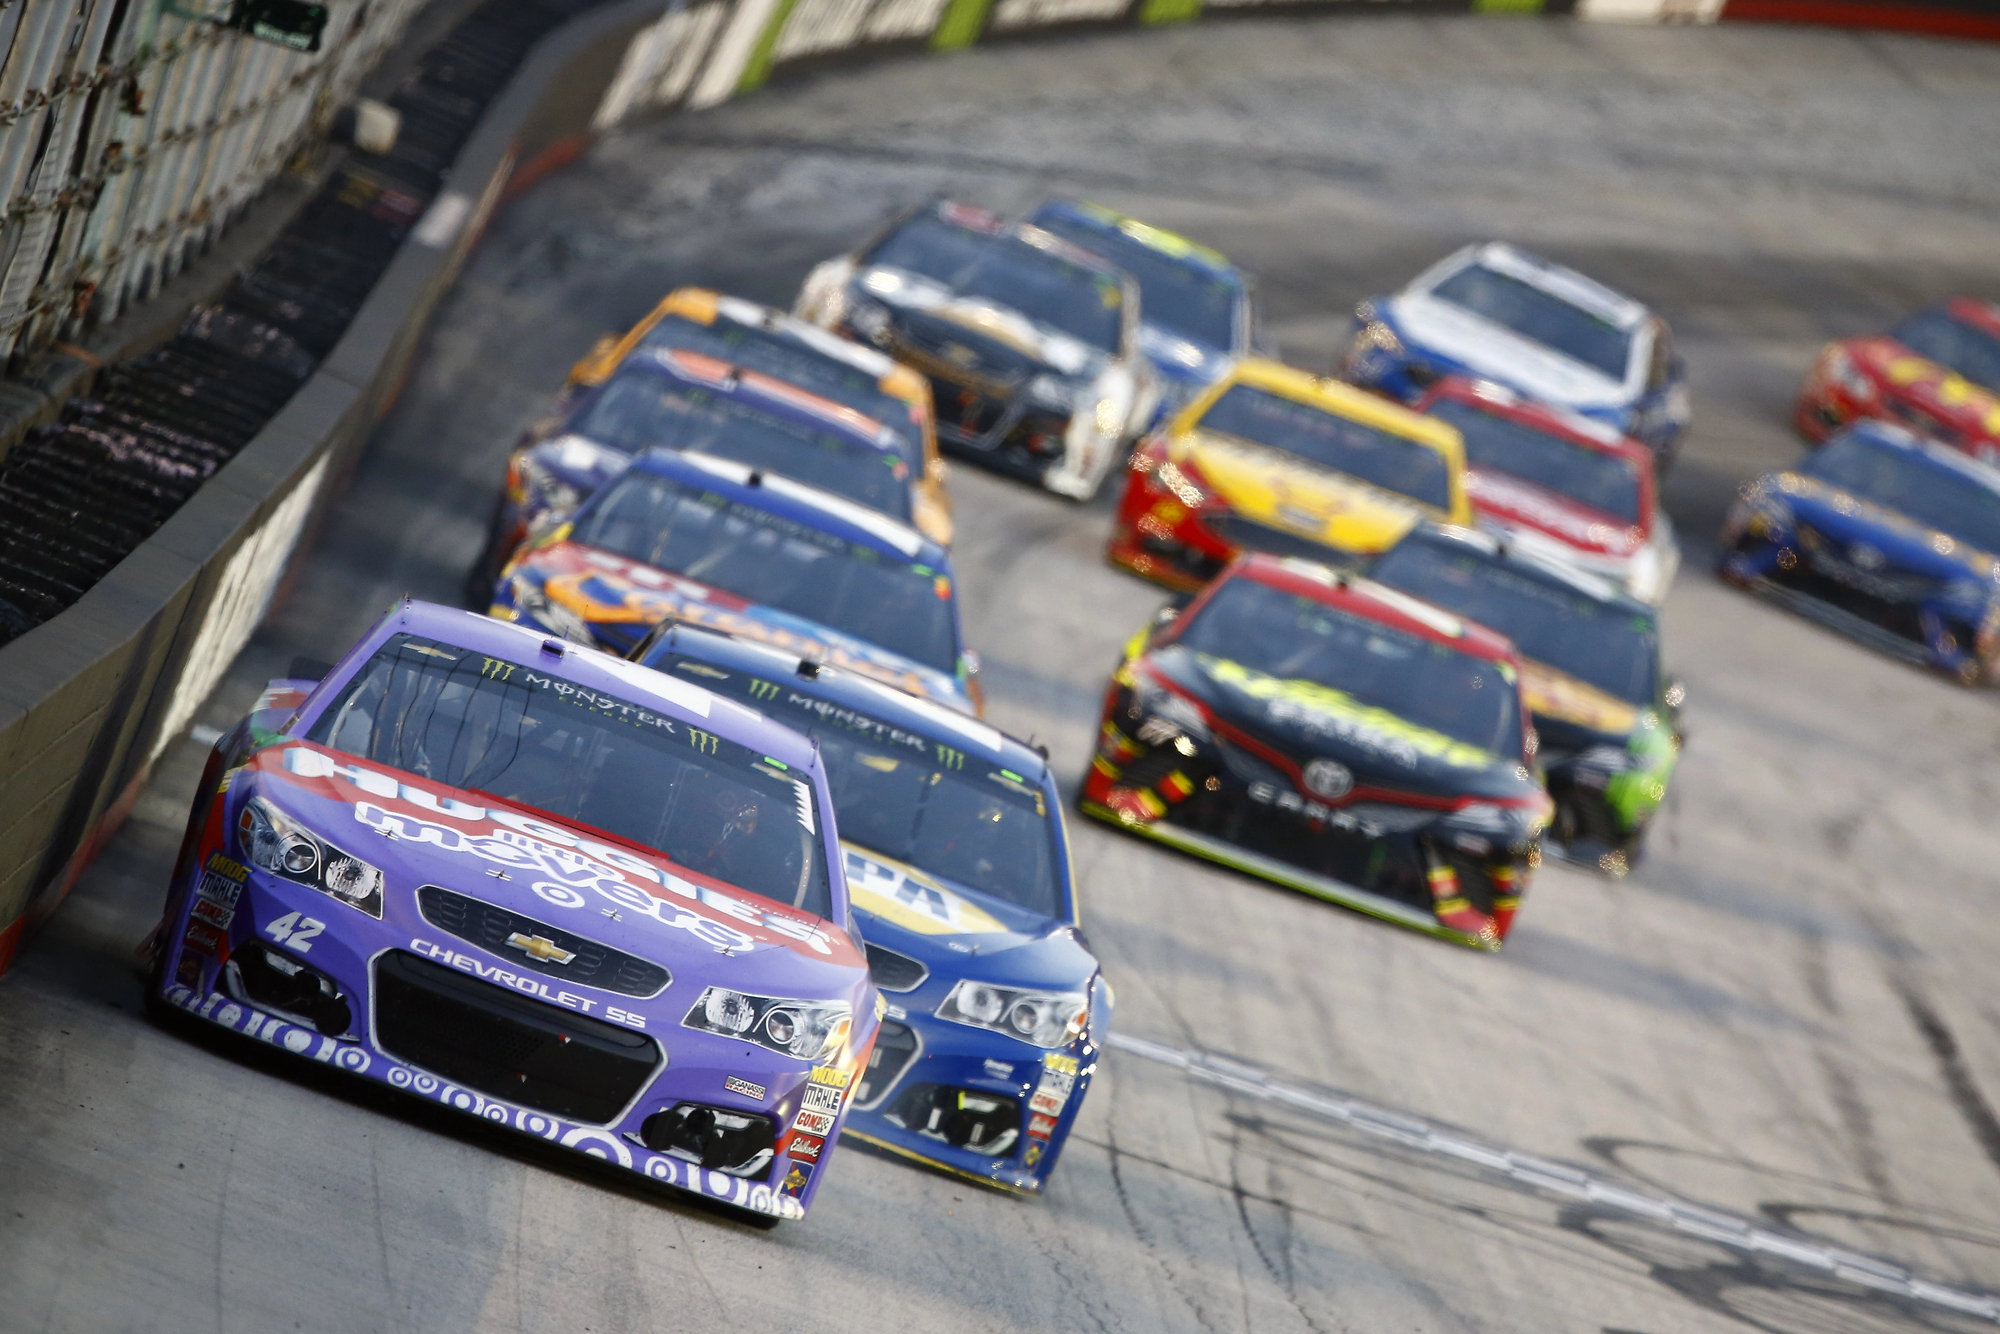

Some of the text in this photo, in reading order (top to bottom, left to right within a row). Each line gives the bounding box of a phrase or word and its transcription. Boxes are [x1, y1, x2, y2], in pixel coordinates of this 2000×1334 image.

[525, 673, 675, 734] MONSTER
[788, 693, 926, 751] MONSTER
[206, 852, 253, 883] MOOG
[284, 747, 833, 955] HUGGIES
[200, 876, 242, 903] MAHLE
[355, 801, 755, 952] movers
[846, 852, 951, 922] PA
[264, 911, 327, 954] 42
[409, 938, 647, 1029] CHEVROLET SS
[726, 1083, 763, 1099] RACING
[811, 1065, 849, 1087] MOOG
[796, 1112, 823, 1128] COMP
[803, 1086, 841, 1111] MAHLE
